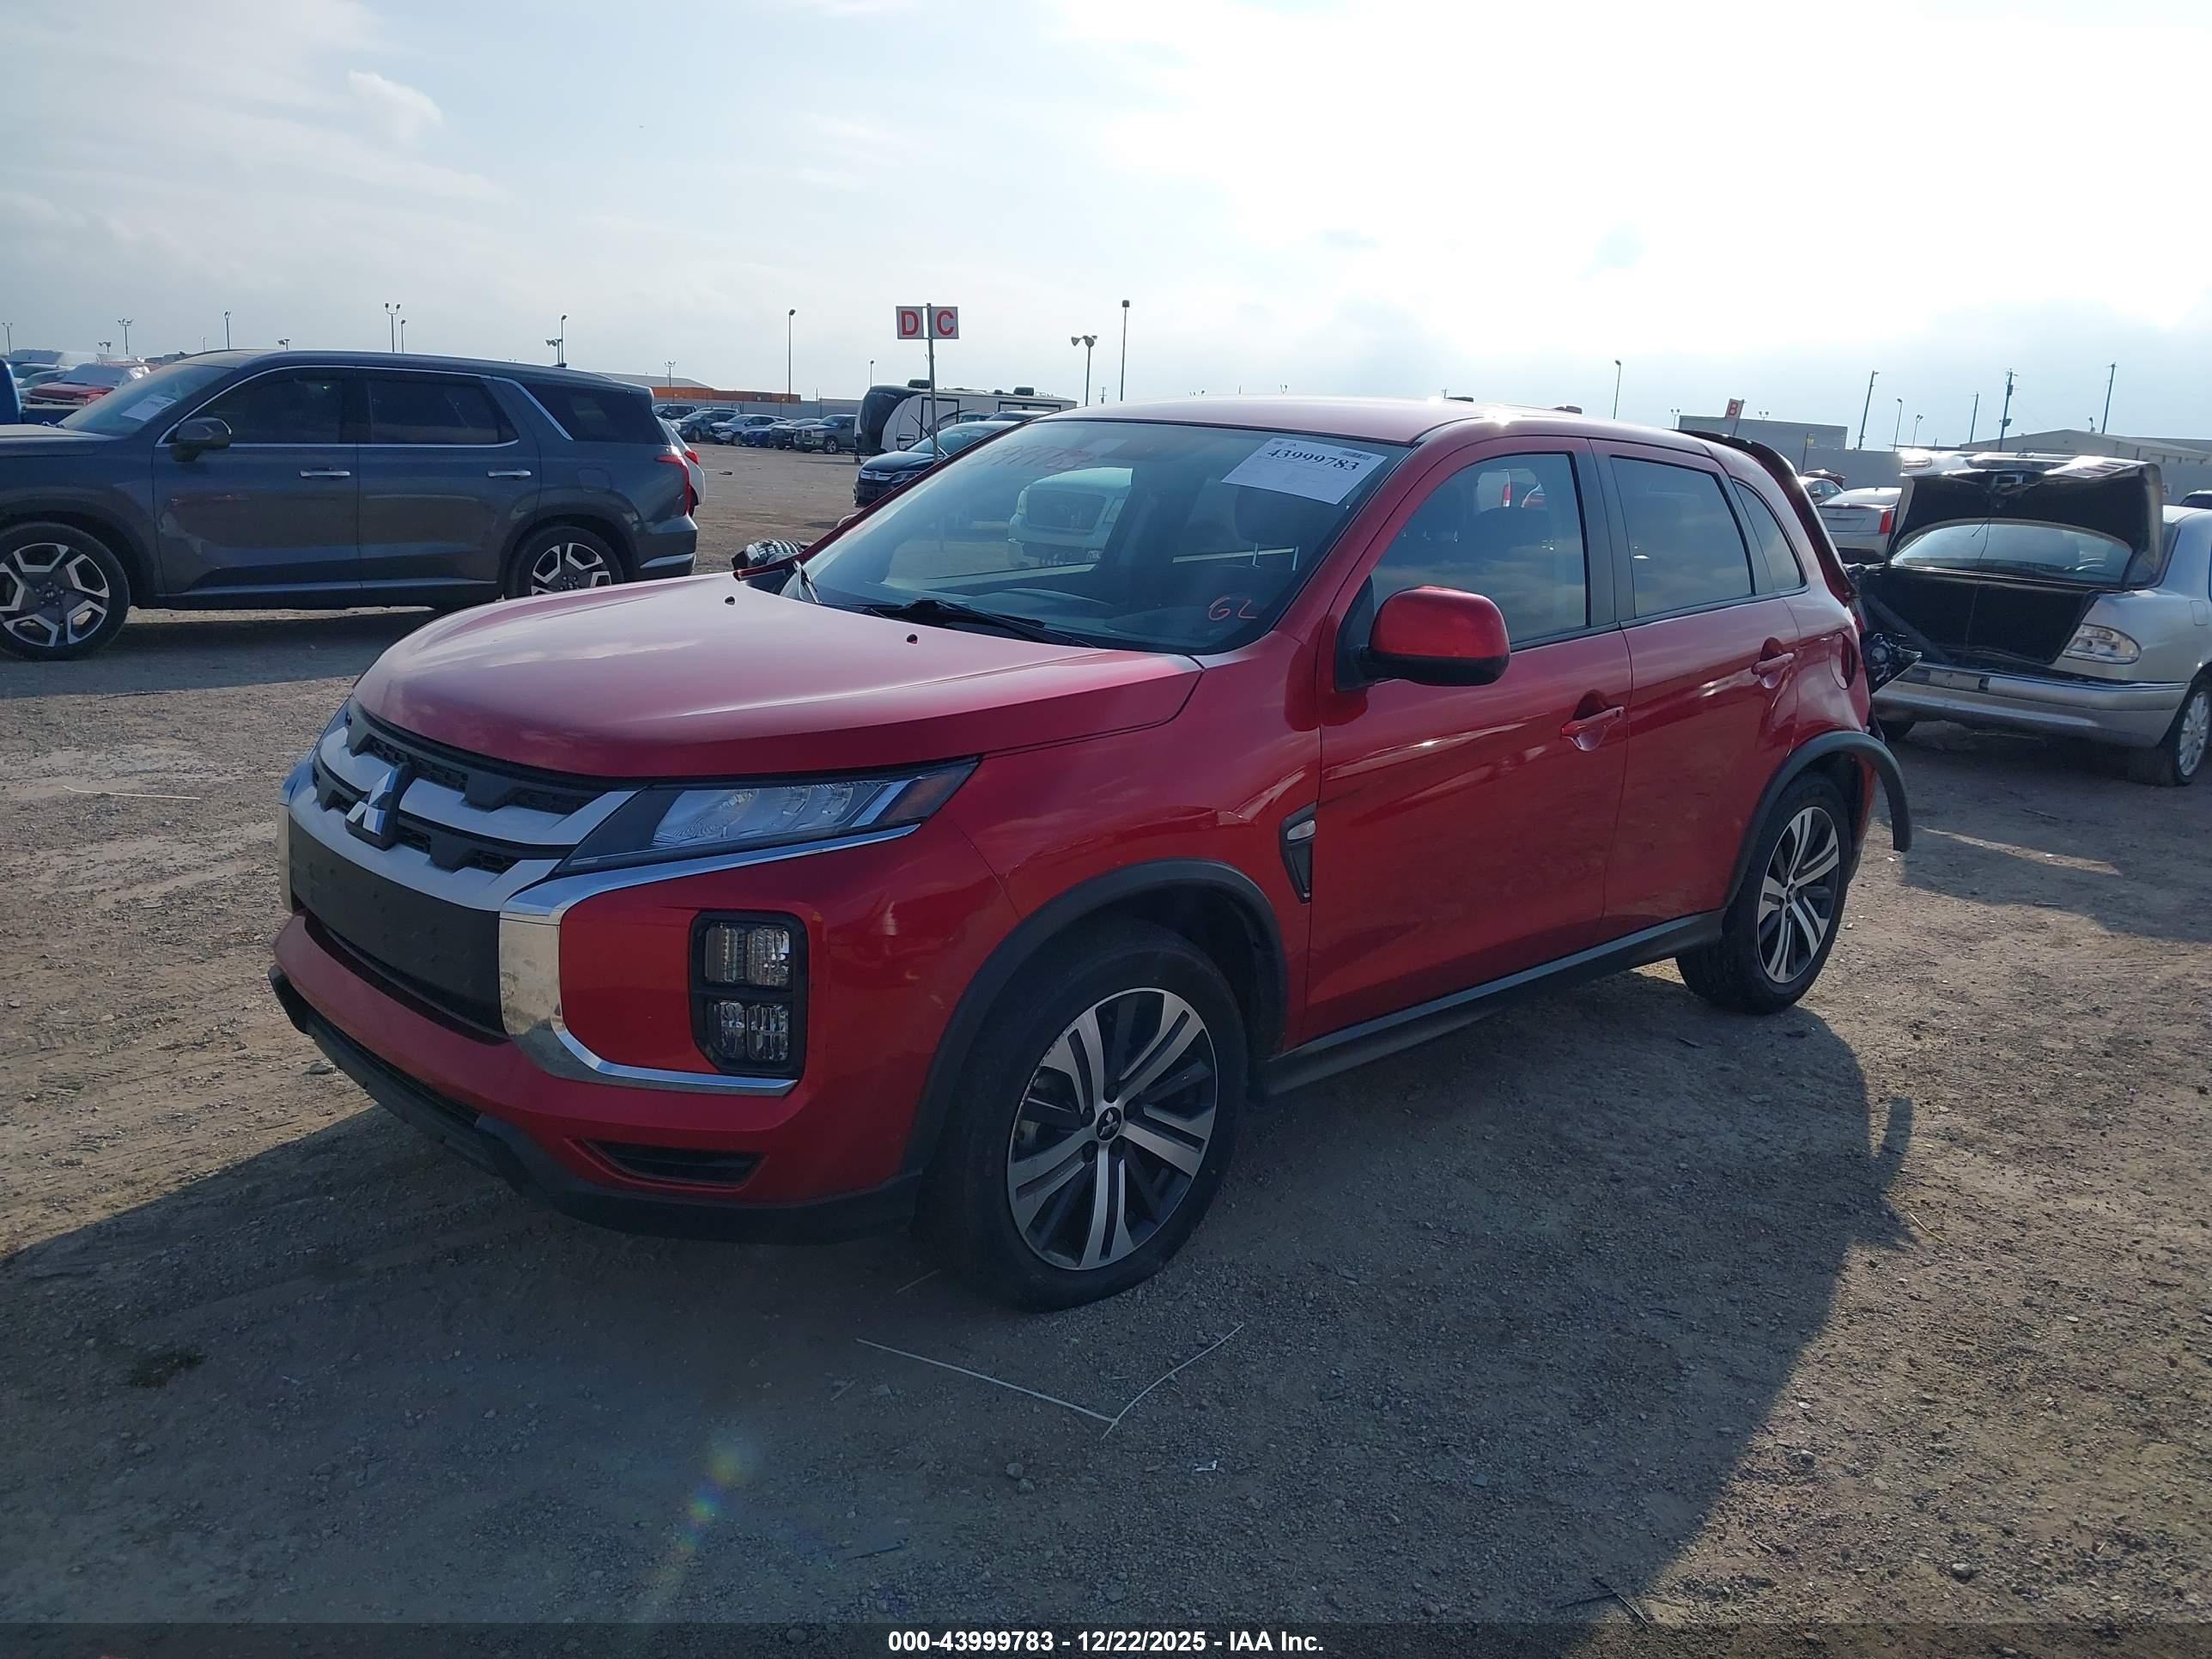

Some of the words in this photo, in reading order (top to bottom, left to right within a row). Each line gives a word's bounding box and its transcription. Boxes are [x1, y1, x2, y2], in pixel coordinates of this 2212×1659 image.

[901, 310, 920, 336] D
[936, 310, 955, 336] C
[1728, 401, 1739, 416] B
[1267, 448, 1360, 471] 43999783
